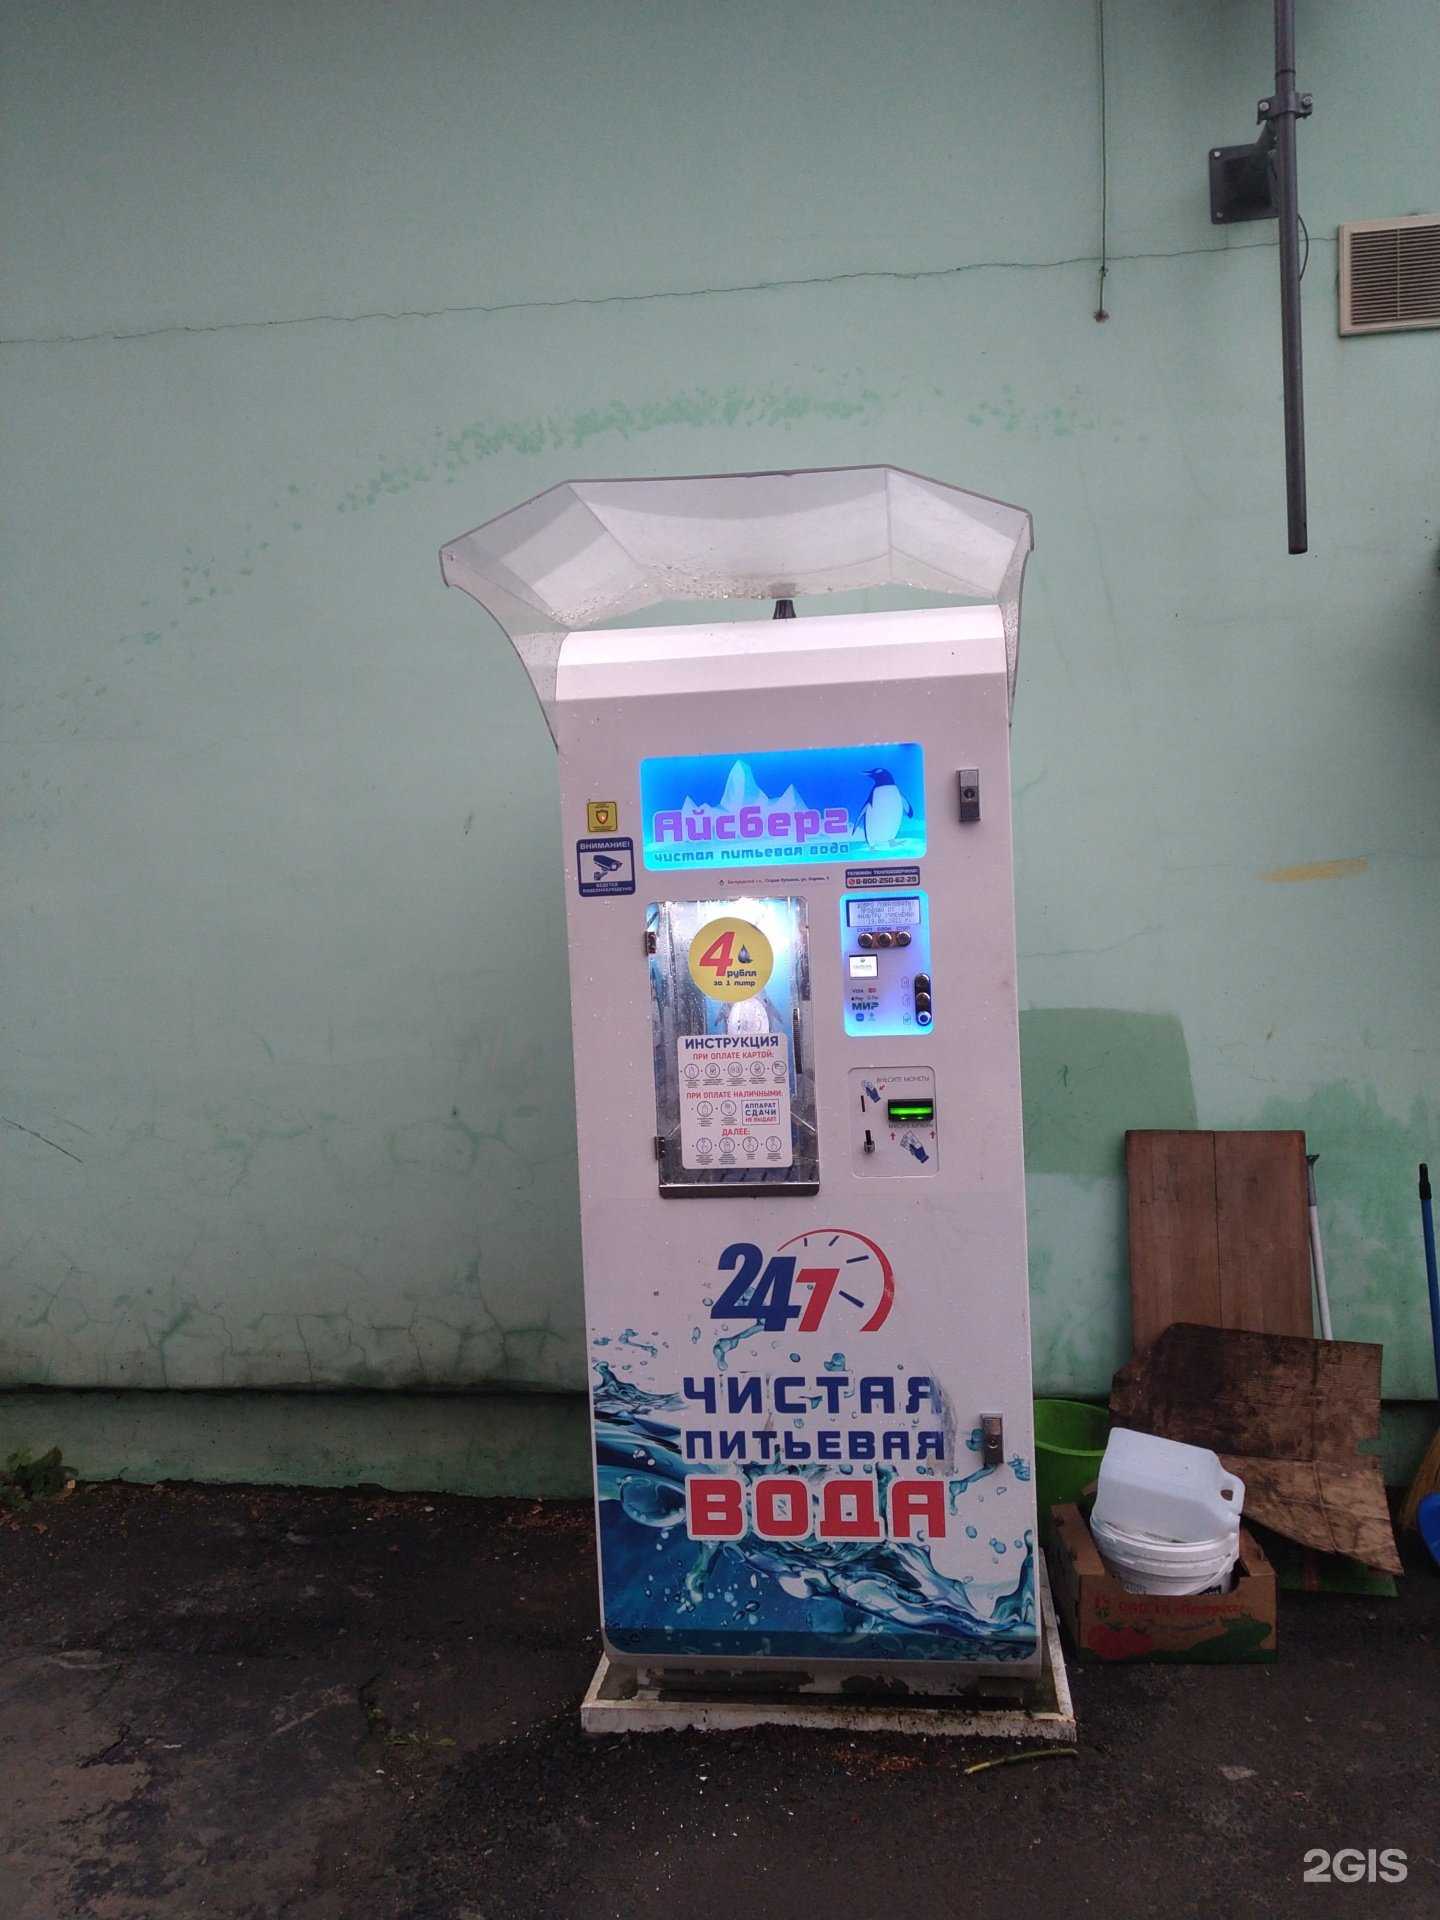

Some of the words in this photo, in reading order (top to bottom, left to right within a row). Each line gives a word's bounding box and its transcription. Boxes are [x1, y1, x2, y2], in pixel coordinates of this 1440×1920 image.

[654, 806, 849, 842] Айсберг
[580, 841, 630, 850] ВНИМАНИЕ!
[654, 851, 714, 862] чистая
[721, 846, 803, 860] питьевая
[810, 843, 849, 855] вода
[699, 931, 736, 977] 4
[726, 969, 757, 978] рубля
[851, 1002, 880, 1011] МИР
[685, 1036, 779, 1049] ИНСТРУКЦИЯ
[704, 1091, 731, 1099] ОПЛАТЕ
[683, 1377, 943, 1414] ЧИСТАЯ
[686, 1431, 945, 1460] ПИТЬЕВАЯ
[689, 1479, 946, 1538] ВОДА
